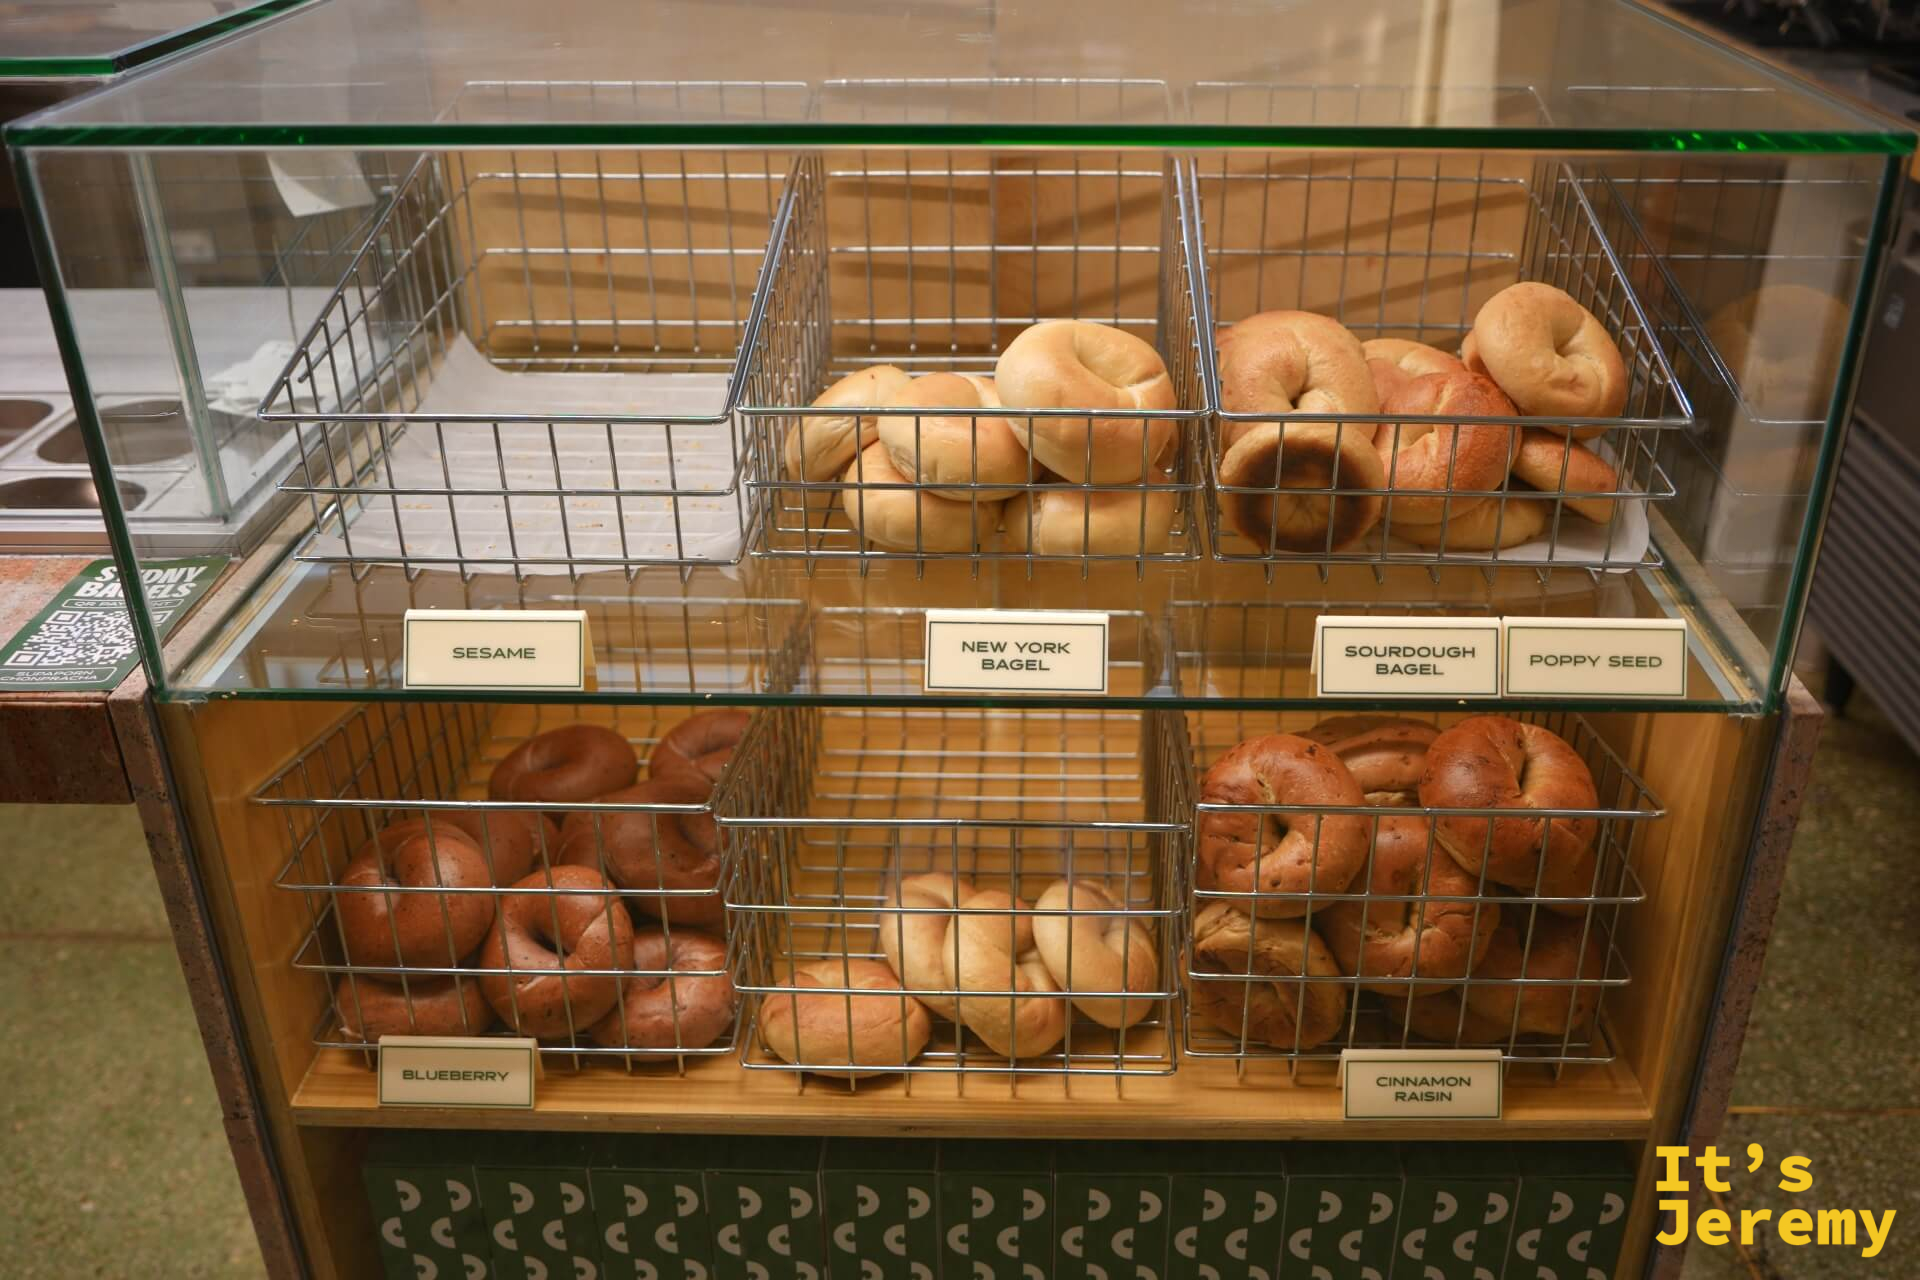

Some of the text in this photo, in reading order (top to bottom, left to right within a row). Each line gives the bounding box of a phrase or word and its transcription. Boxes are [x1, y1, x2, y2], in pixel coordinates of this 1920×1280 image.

[95, 565, 208, 584] SDNY
[98, 600, 173, 608] PAYNT
[451, 647, 537, 659] SESAME
[961, 641, 1071, 654] NEW YORK
[1345, 645, 1476, 658] SOURDOUGH
[981, 658, 1050, 671] BAGEL
[1529, 655, 1663, 668] POPPY SEED
[1375, 663, 1444, 675] BAGEL
[402, 1069, 509, 1082] BLUEBERRY
[1375, 1076, 1472, 1087] CINNAMON
[1394, 1091, 1453, 1102] RAISIN
